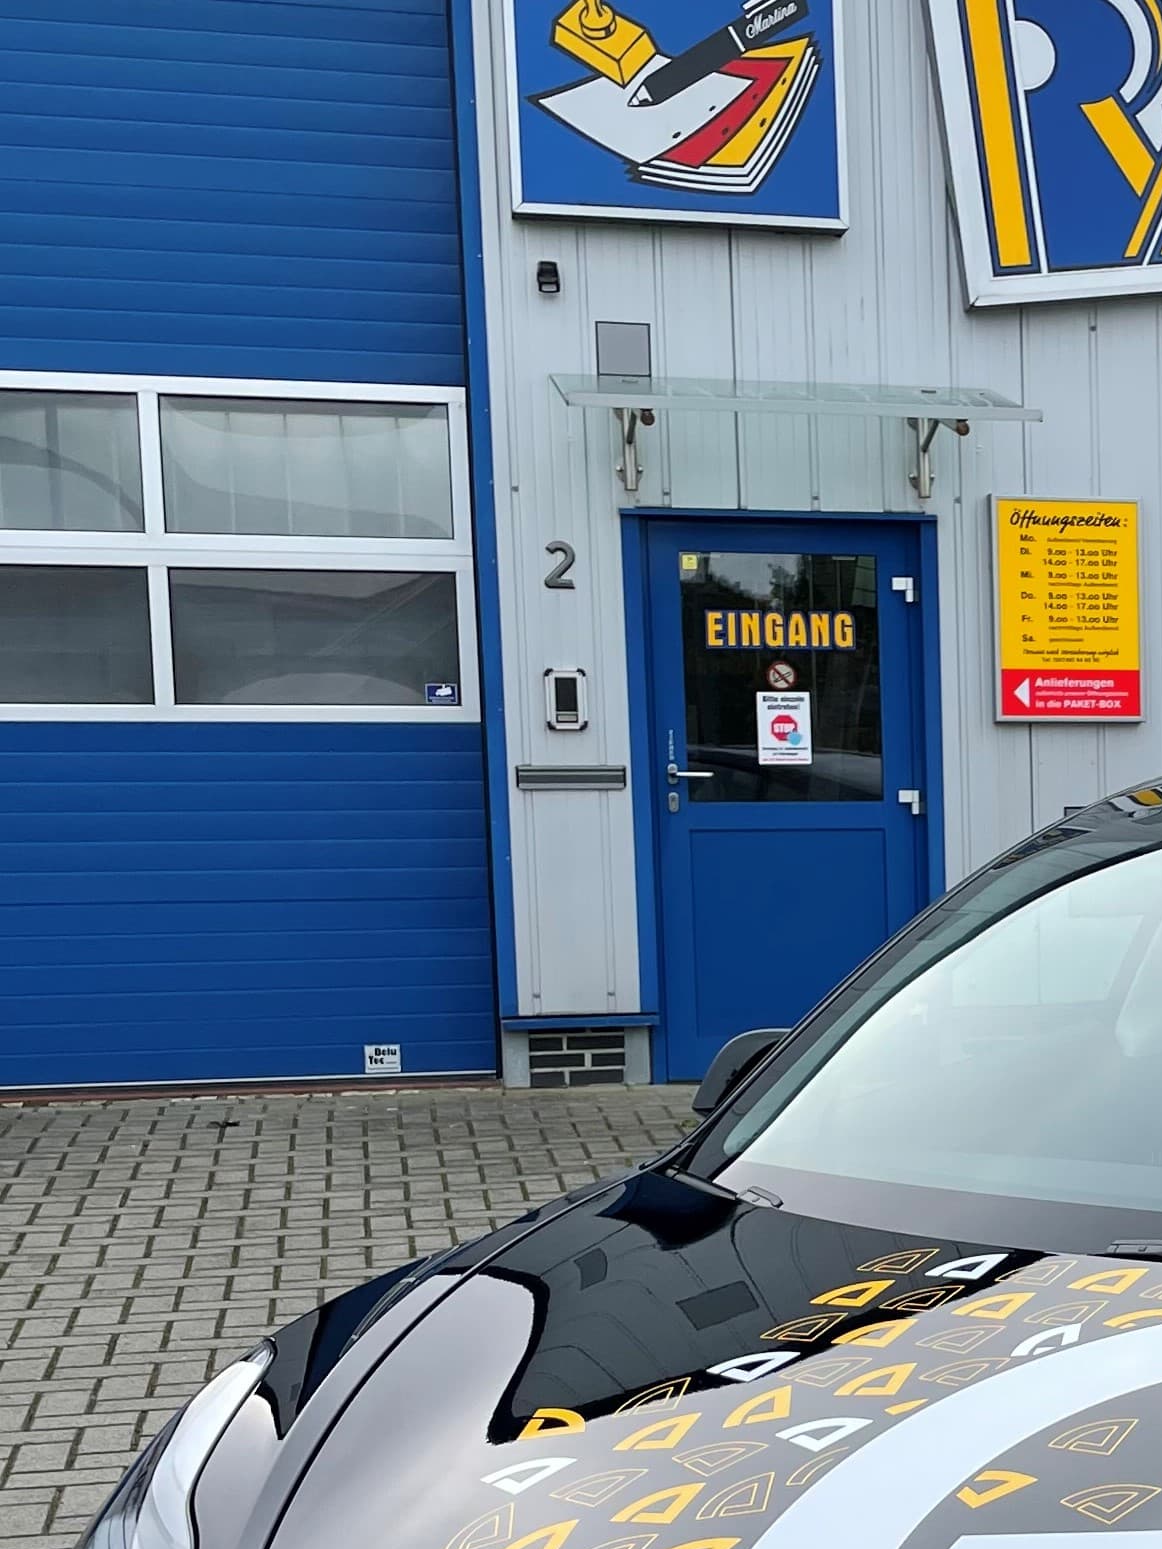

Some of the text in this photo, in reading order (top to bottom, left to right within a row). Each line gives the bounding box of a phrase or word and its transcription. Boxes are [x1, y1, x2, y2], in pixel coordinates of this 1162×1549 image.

[745, 2, 798, 39] Martina
[1010, 508, 1128, 533] Öffnungszeiten:
[1020, 534, 1037, 542] Mo.
[1020, 547, 1032, 555] Di.
[544, 540, 576, 590] 2
[1043, 558, 1067, 566] 14.00
[1102, 559, 1118, 567] Uhr
[1020, 570, 1034, 578] Mi.
[1102, 572, 1118, 580] Uhr
[1020, 592, 1036, 600] Do.
[1044, 602, 1067, 610] 14.00
[1103, 616, 1119, 624] Uhr
[706, 611, 856, 649] EINGANG
[1022, 634, 1036, 642] Sa.
[1034, 677, 1114, 689] Anlieferungen
[1035, 699, 1122, 709] in die PAKET-BOX
